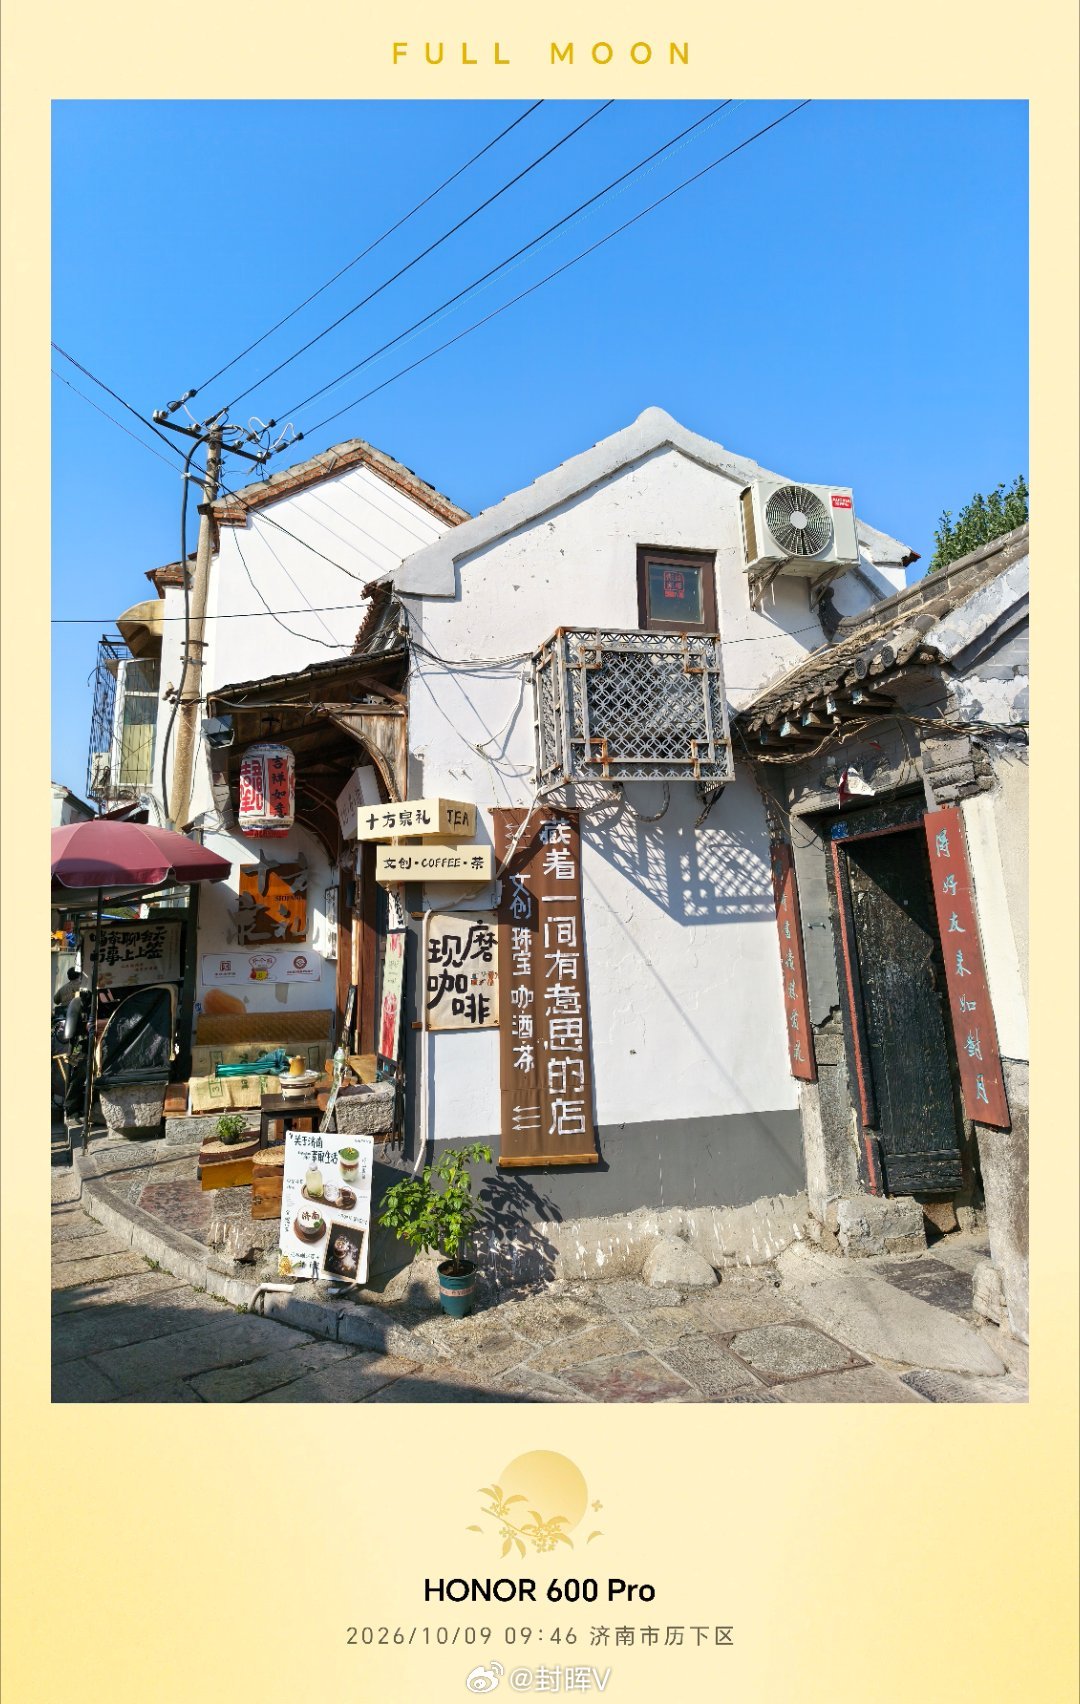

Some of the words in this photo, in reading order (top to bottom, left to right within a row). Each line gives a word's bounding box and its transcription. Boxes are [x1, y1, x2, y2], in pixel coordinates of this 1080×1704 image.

[271, 755, 287, 818] 吉祥如意
[366, 809, 431, 830] 十方泉礼
[446, 809, 469, 831] TEA
[428, 919, 498, 968] 现磨
[427, 968, 491, 1024] 咖啡
[539, 817, 586, 1135] 藏着一间有意思的店
[302, 1210, 320, 1221] 济南
